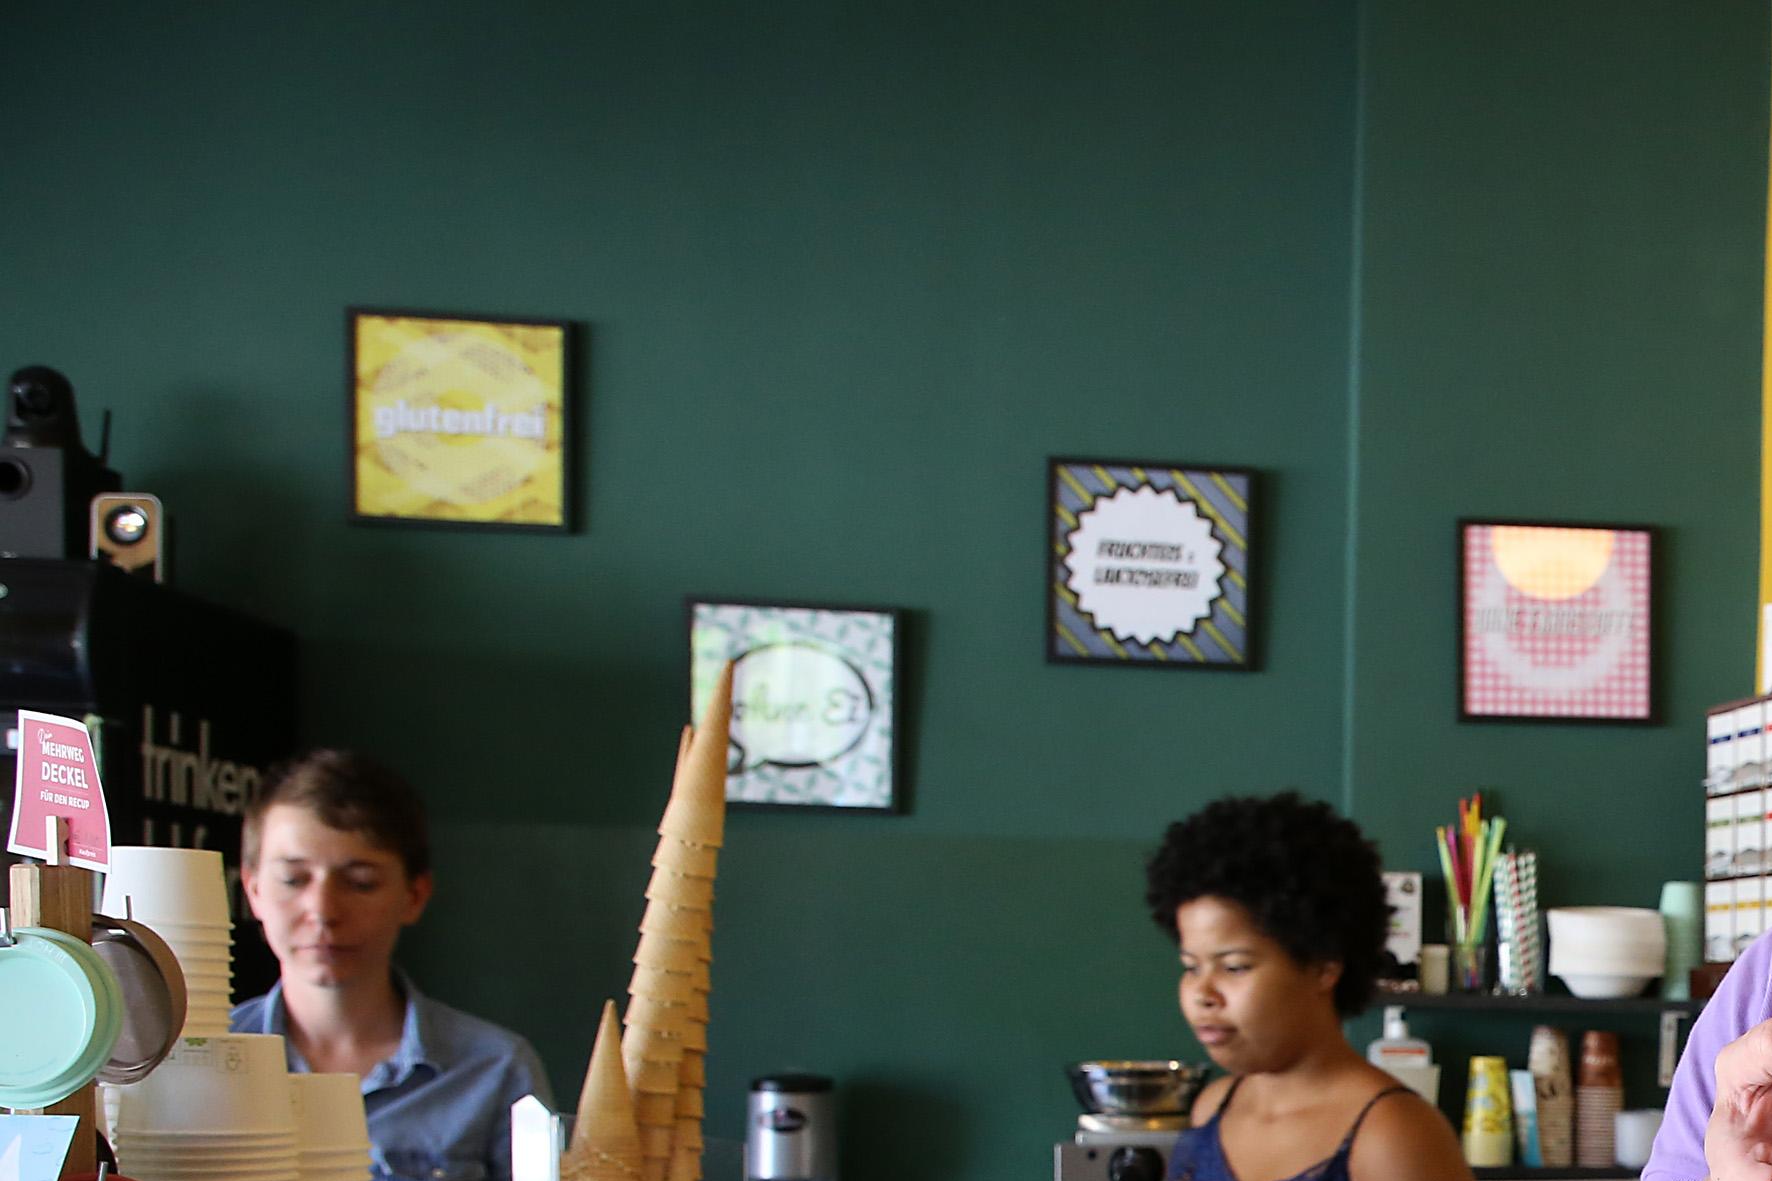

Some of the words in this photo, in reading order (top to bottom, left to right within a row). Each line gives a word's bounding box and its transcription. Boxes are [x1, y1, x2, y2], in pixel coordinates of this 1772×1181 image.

[374, 399, 546, 439] glutenfrei
[42, 741, 85, 763] MEHRWEG
[41, 761, 89, 789] DECKEL
[40, 789, 54, 802] FÜR
[54, 793, 68, 805] DEN
[68, 796, 90, 810] RECUP
